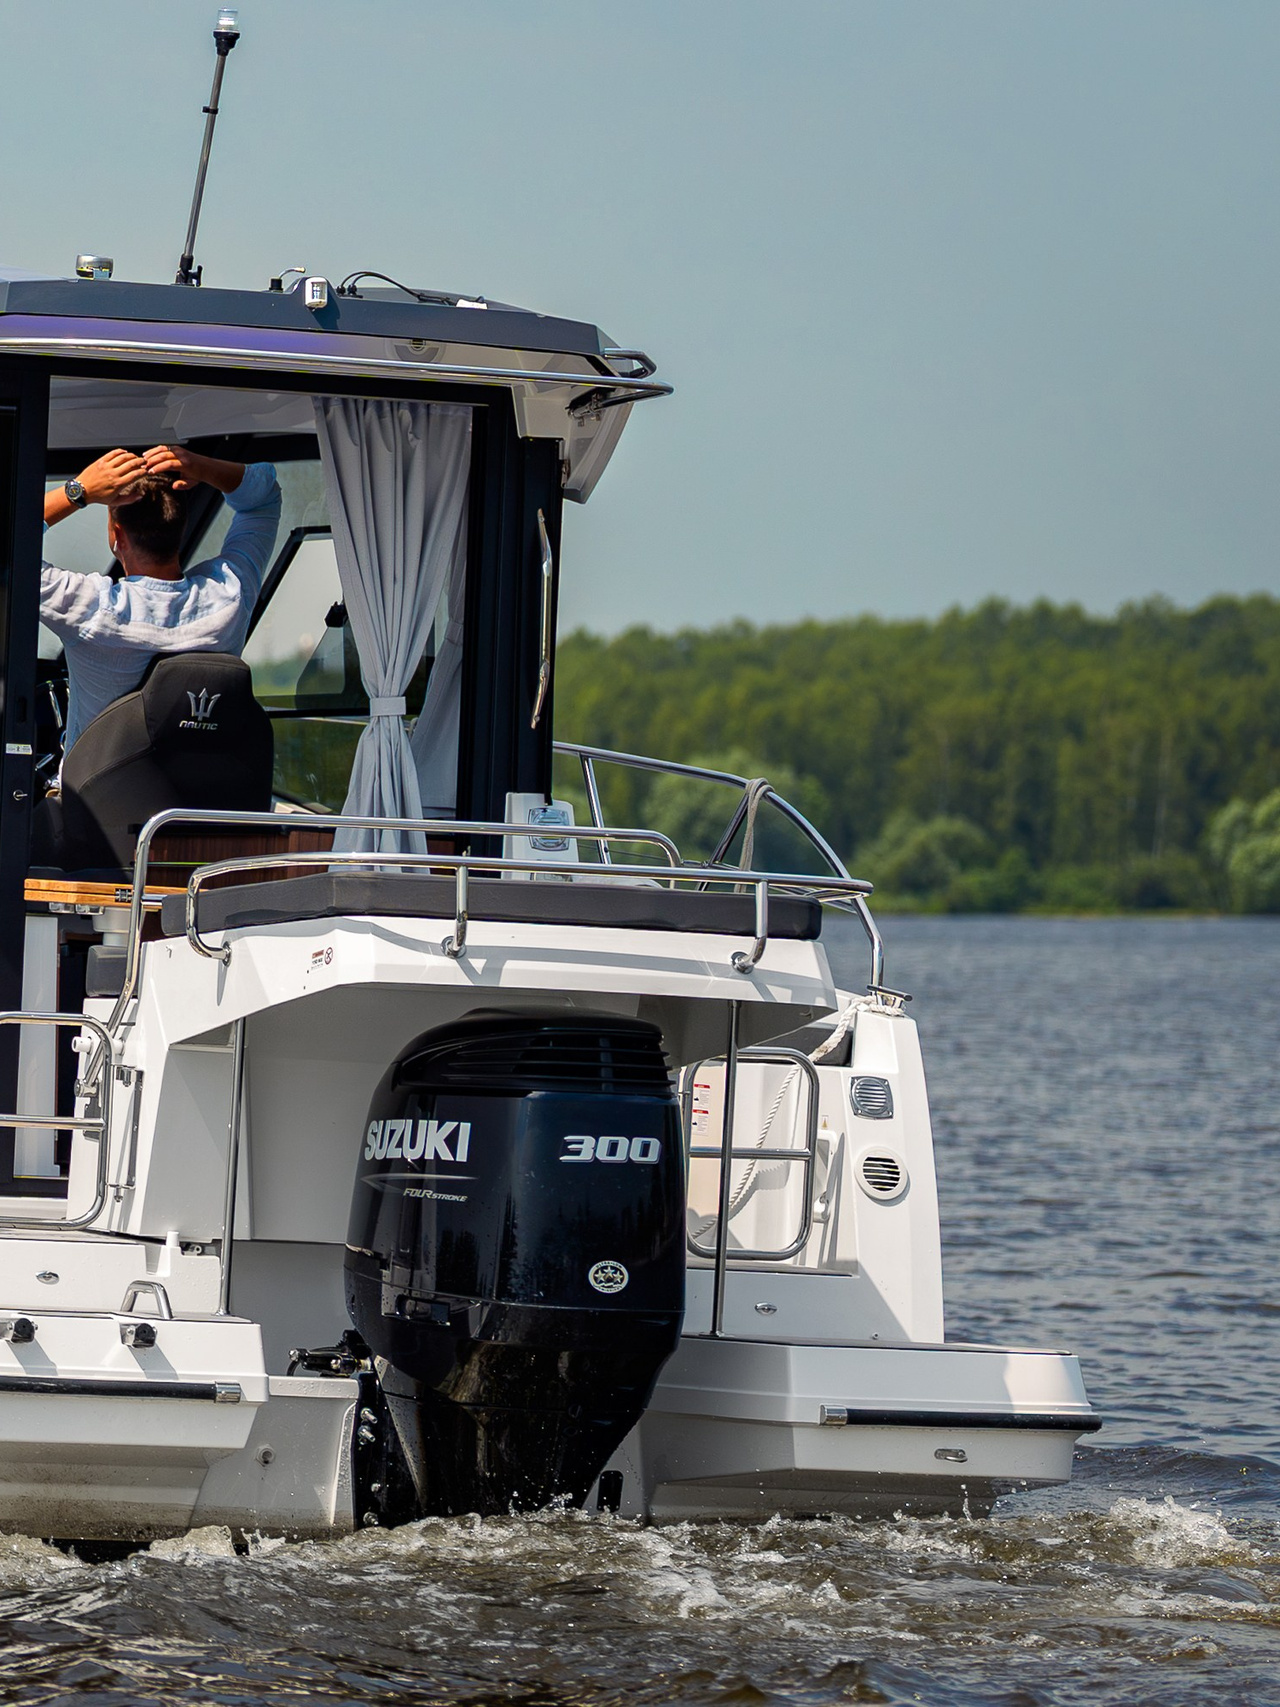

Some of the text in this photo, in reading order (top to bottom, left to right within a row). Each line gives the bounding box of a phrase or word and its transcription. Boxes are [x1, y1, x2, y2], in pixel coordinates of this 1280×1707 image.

[179, 720, 218, 730] NAUTIC
[364, 1119, 471, 1162] SUZUKI
[559, 1135, 661, 1164] 300
